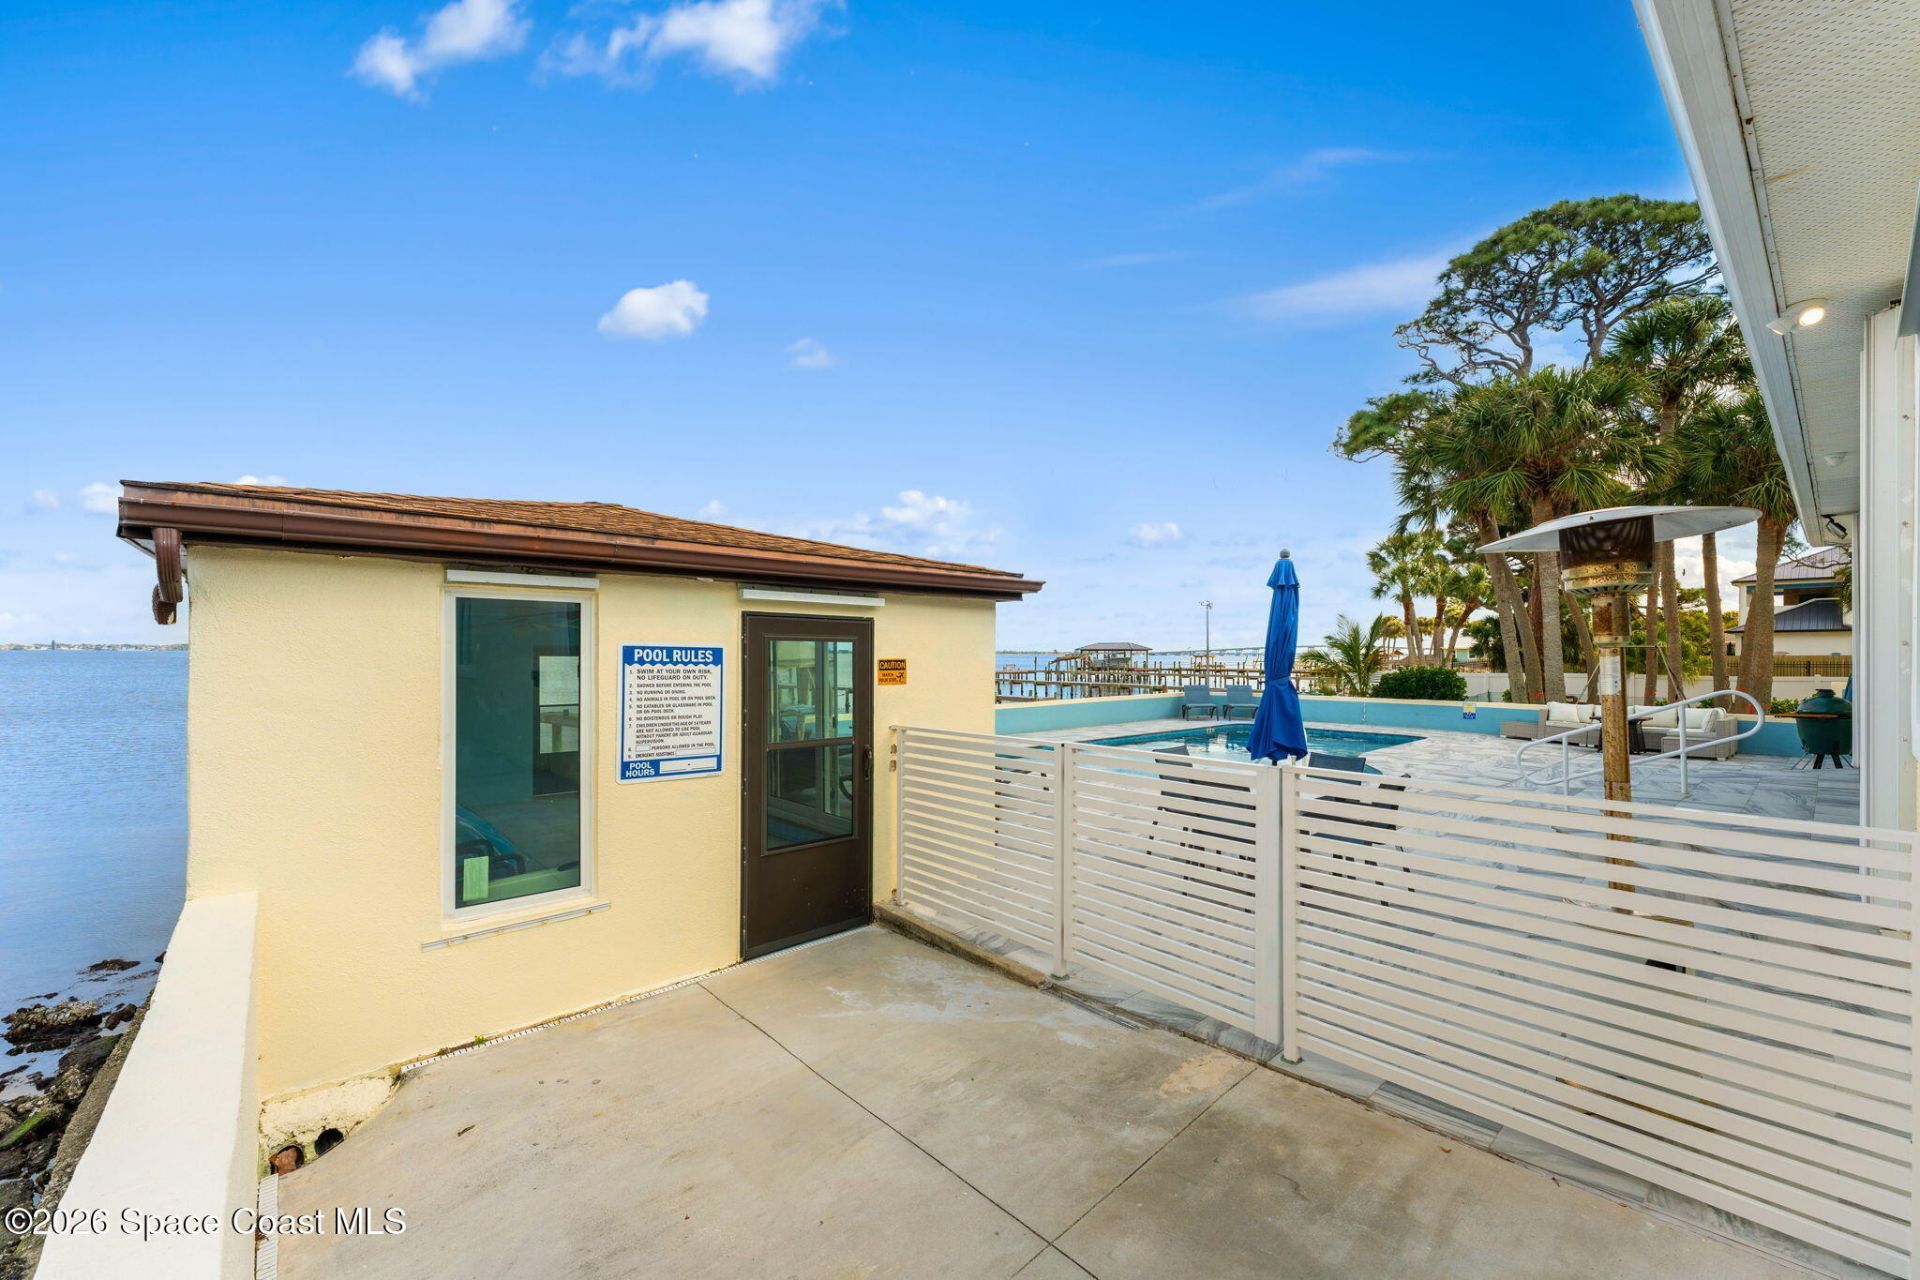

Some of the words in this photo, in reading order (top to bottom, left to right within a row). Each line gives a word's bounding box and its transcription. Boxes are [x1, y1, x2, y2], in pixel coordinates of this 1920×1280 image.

[635, 649, 670, 661] POOL
[673, 650, 713, 662] RULES
[626, 769, 655, 777] HOURS
